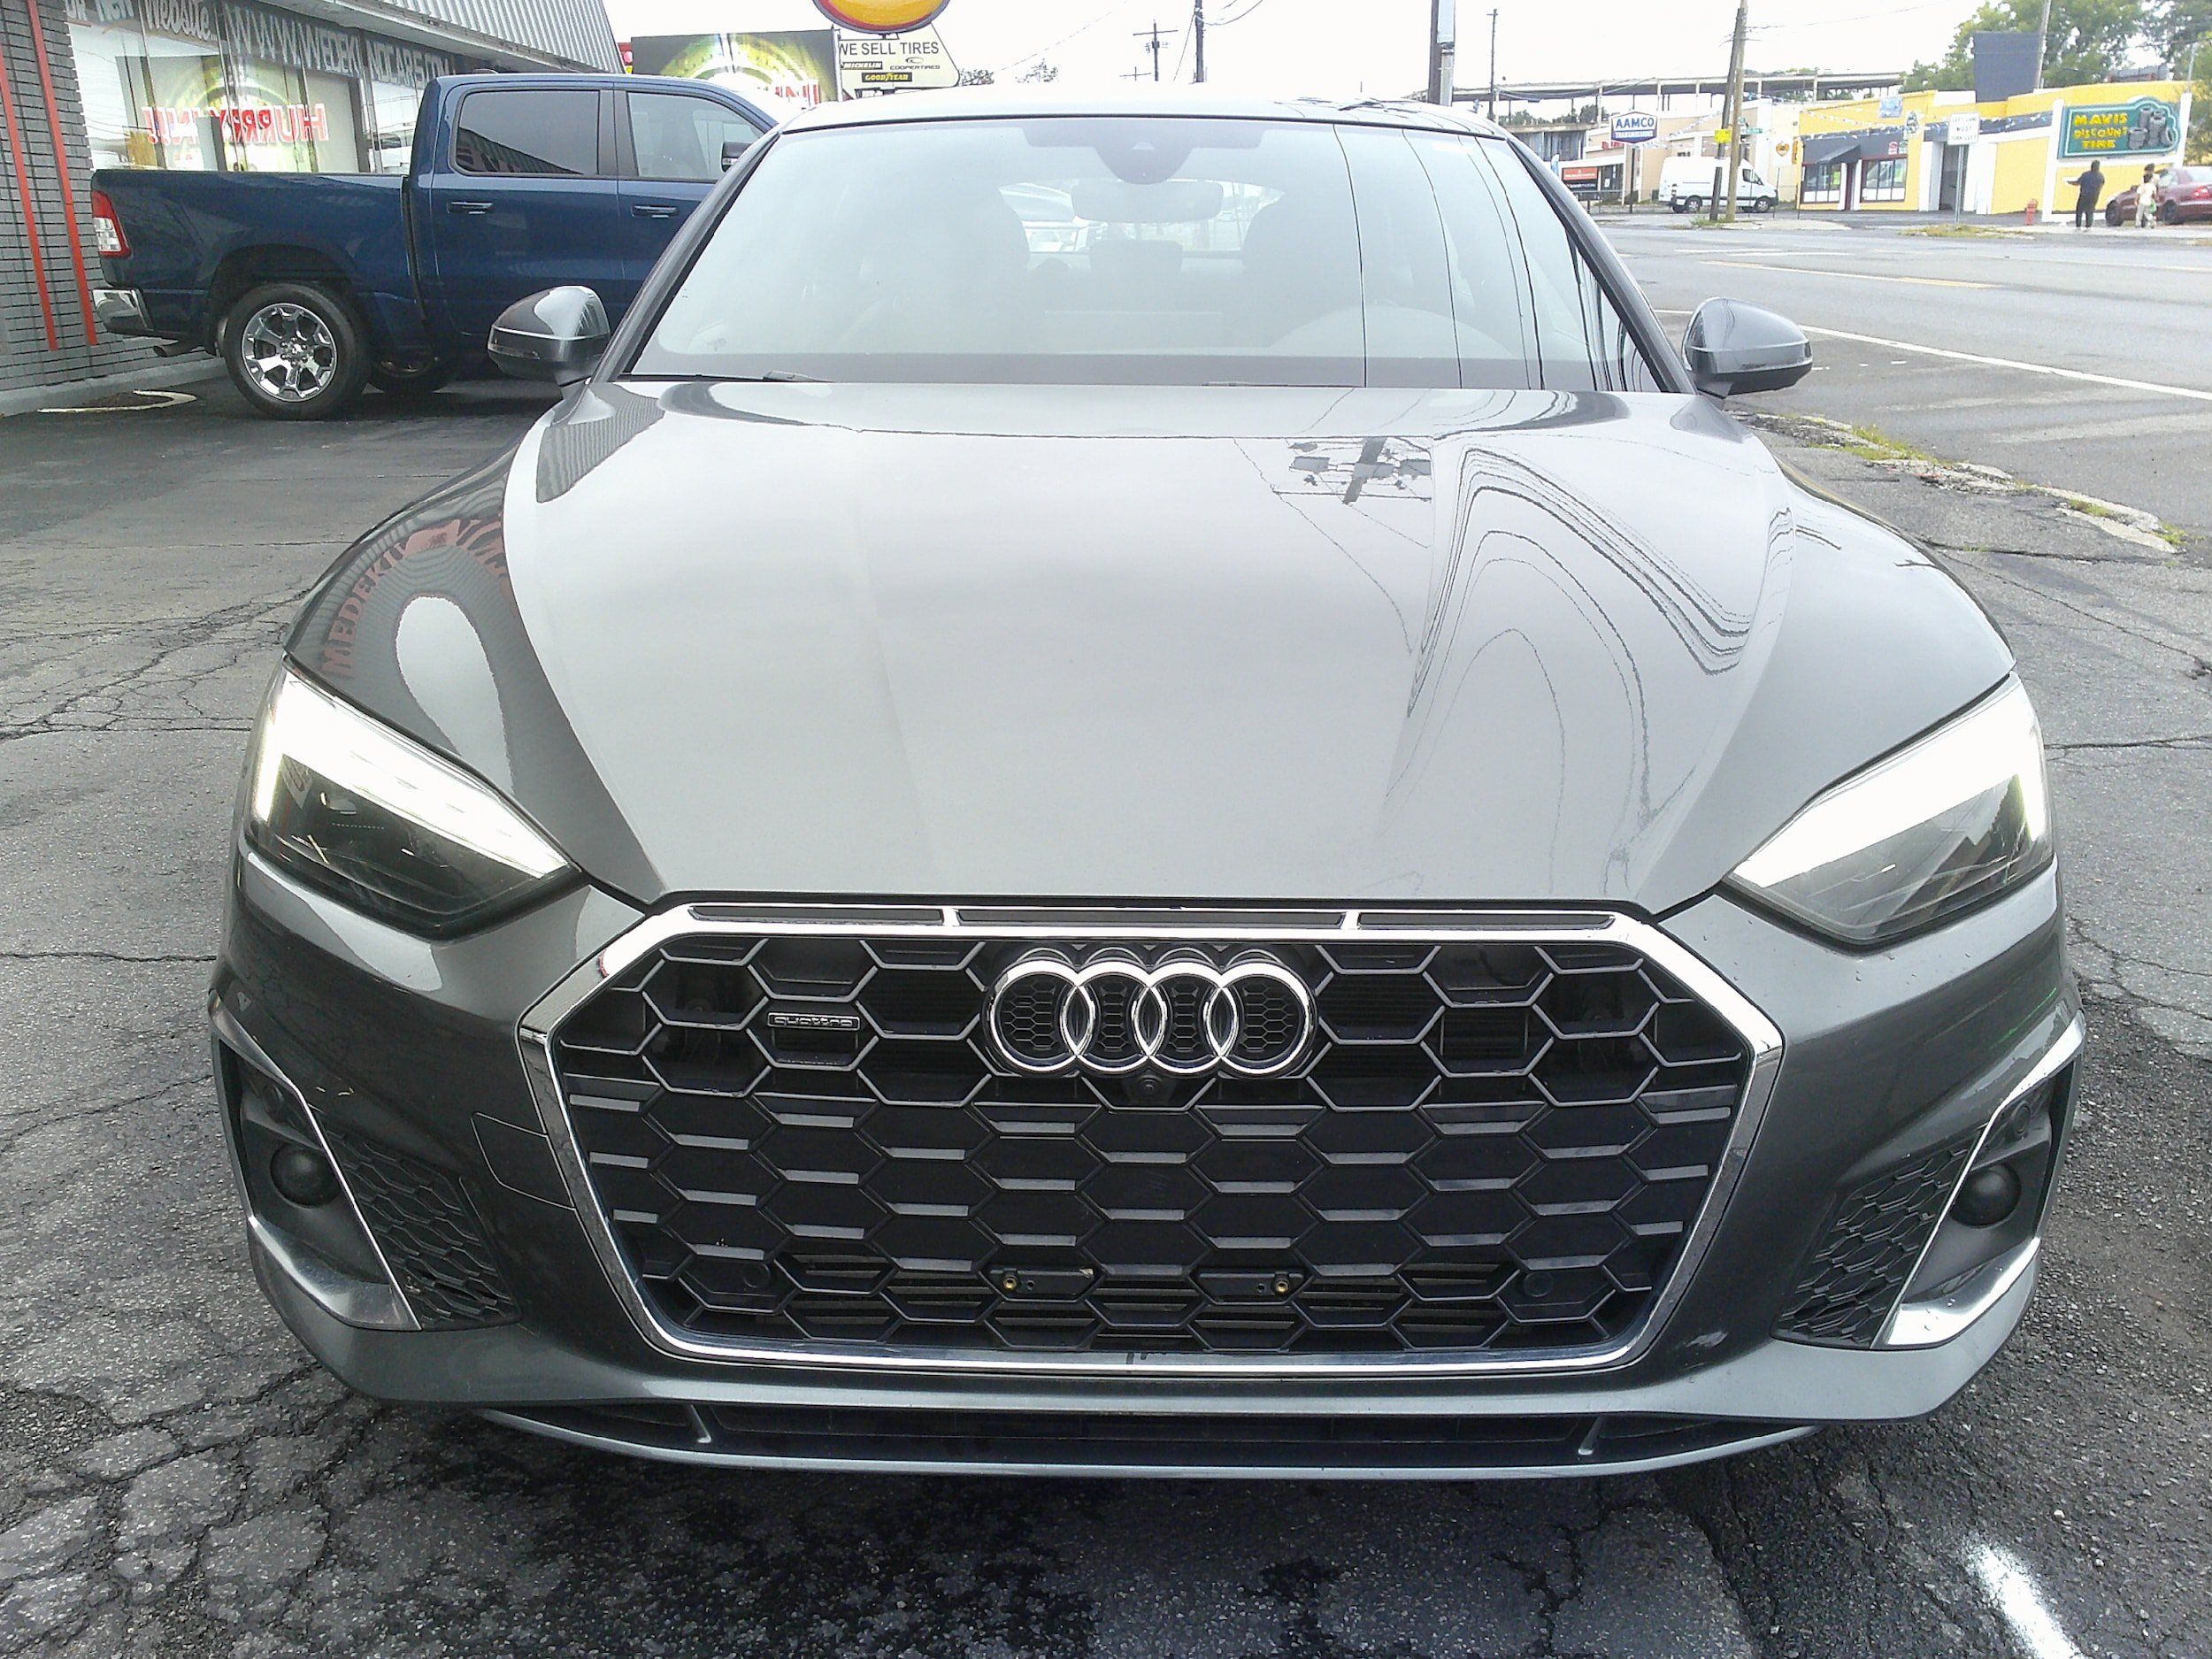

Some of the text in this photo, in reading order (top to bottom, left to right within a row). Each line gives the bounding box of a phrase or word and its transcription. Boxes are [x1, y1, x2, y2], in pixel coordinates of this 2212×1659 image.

[840, 42, 939, 56] WE SELL TIRES
[864, 73, 909, 81] GOODYEAR
[1616, 117, 1655, 129] AAMCO
[2073, 113, 2127, 126] MAVIS
[2073, 127, 2127, 139] DISCOUNT
[2082, 139, 2116, 149] TIRE
[774, 1016, 852, 1026] quattro
